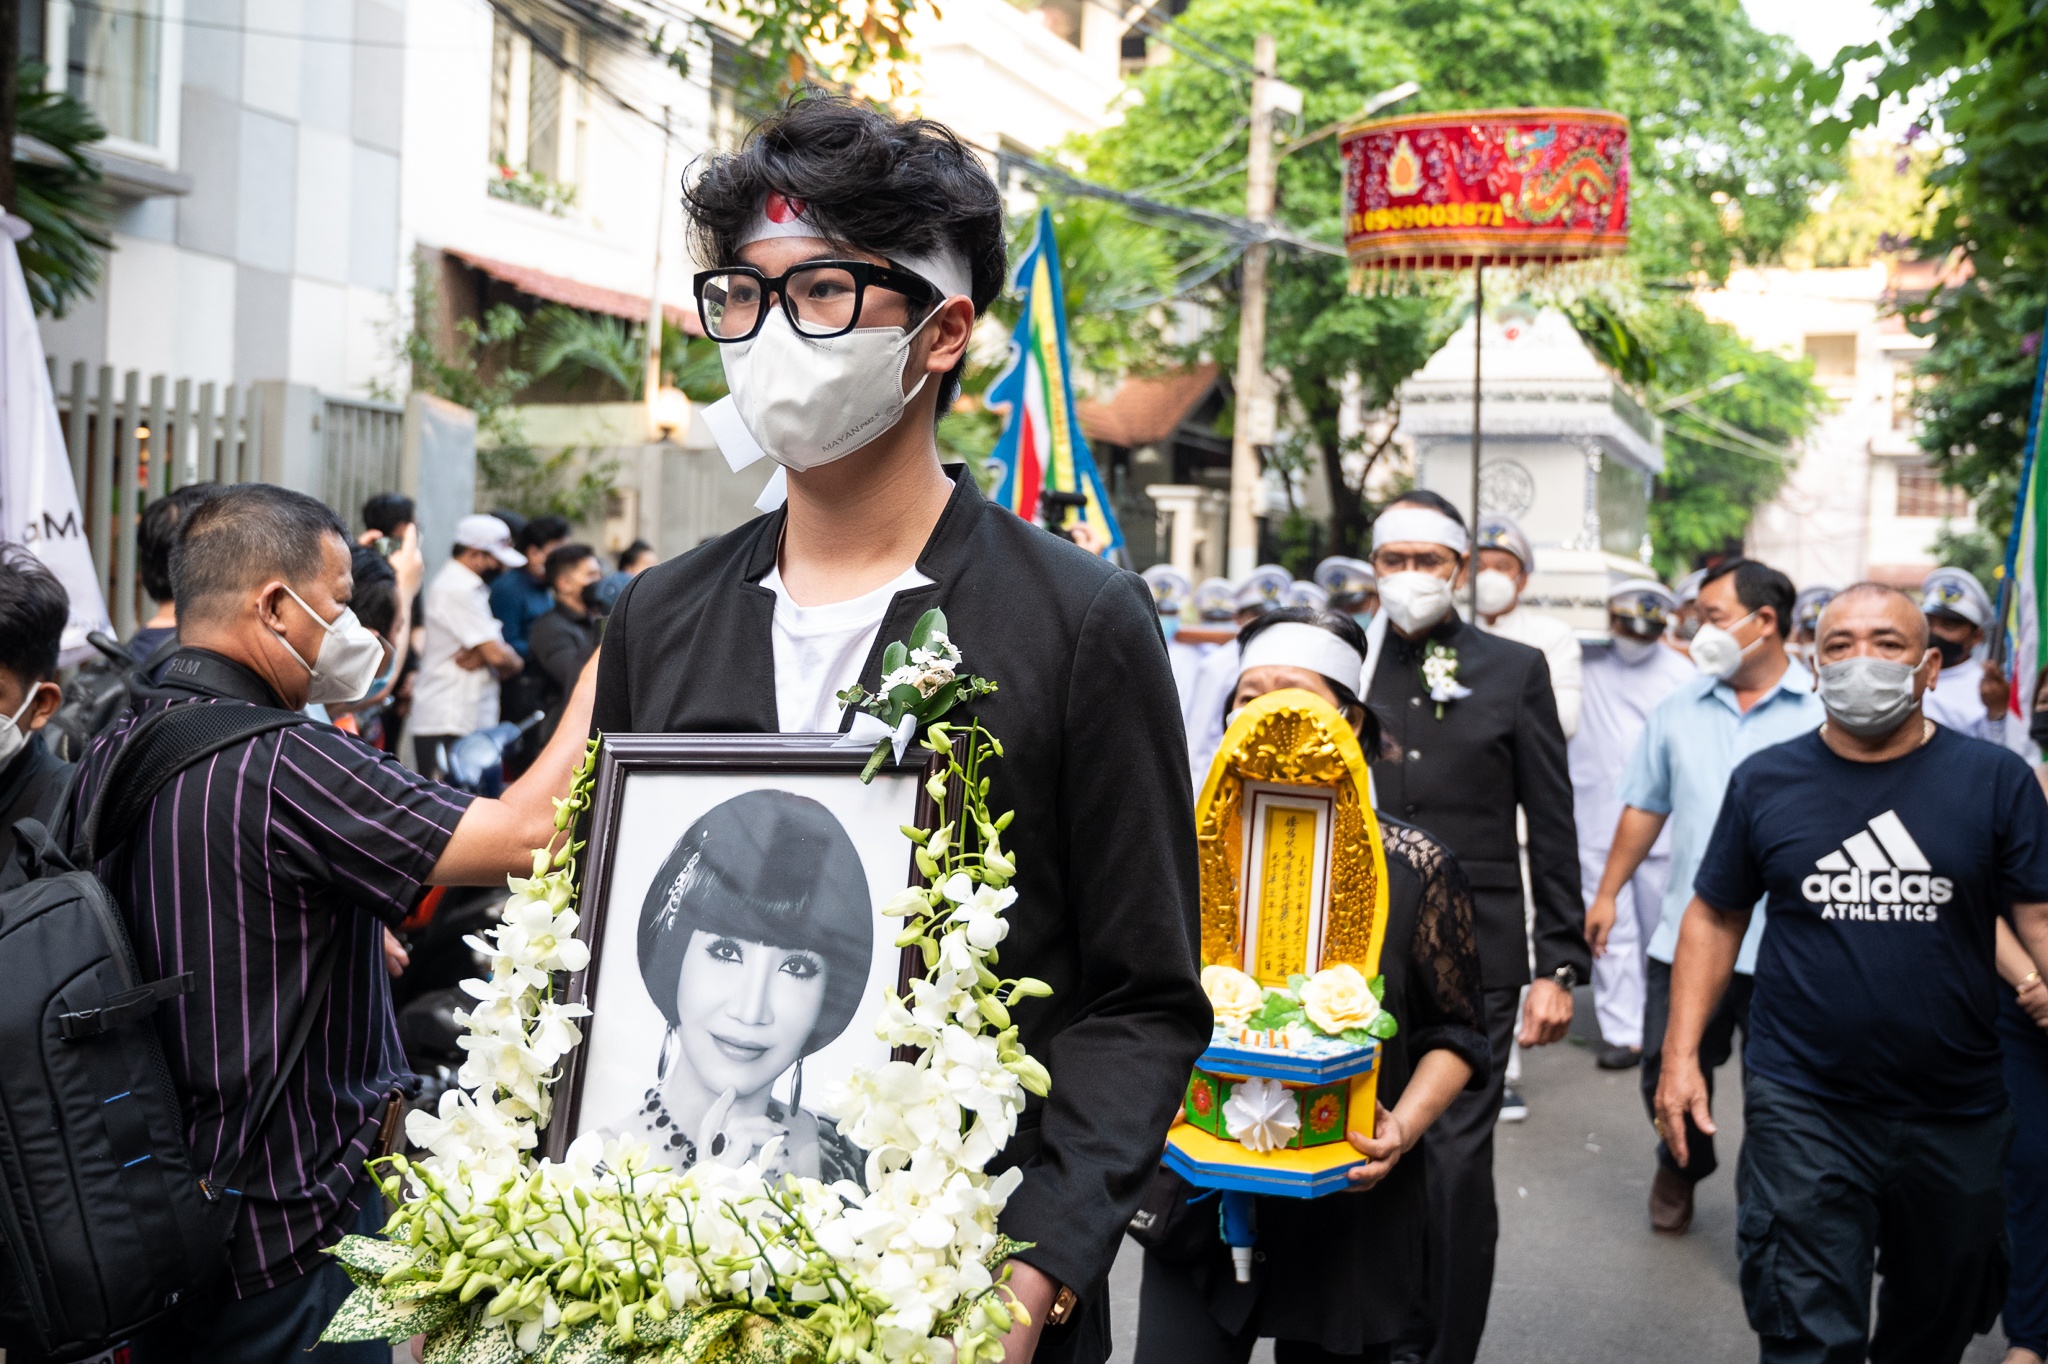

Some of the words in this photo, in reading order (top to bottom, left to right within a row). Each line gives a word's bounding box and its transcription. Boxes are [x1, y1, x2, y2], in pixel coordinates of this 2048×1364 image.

[822, 426, 860, 452] MAYAN
[1801, 866, 1954, 904] adidas
[1821, 903, 1938, 922] ATHLETICS
